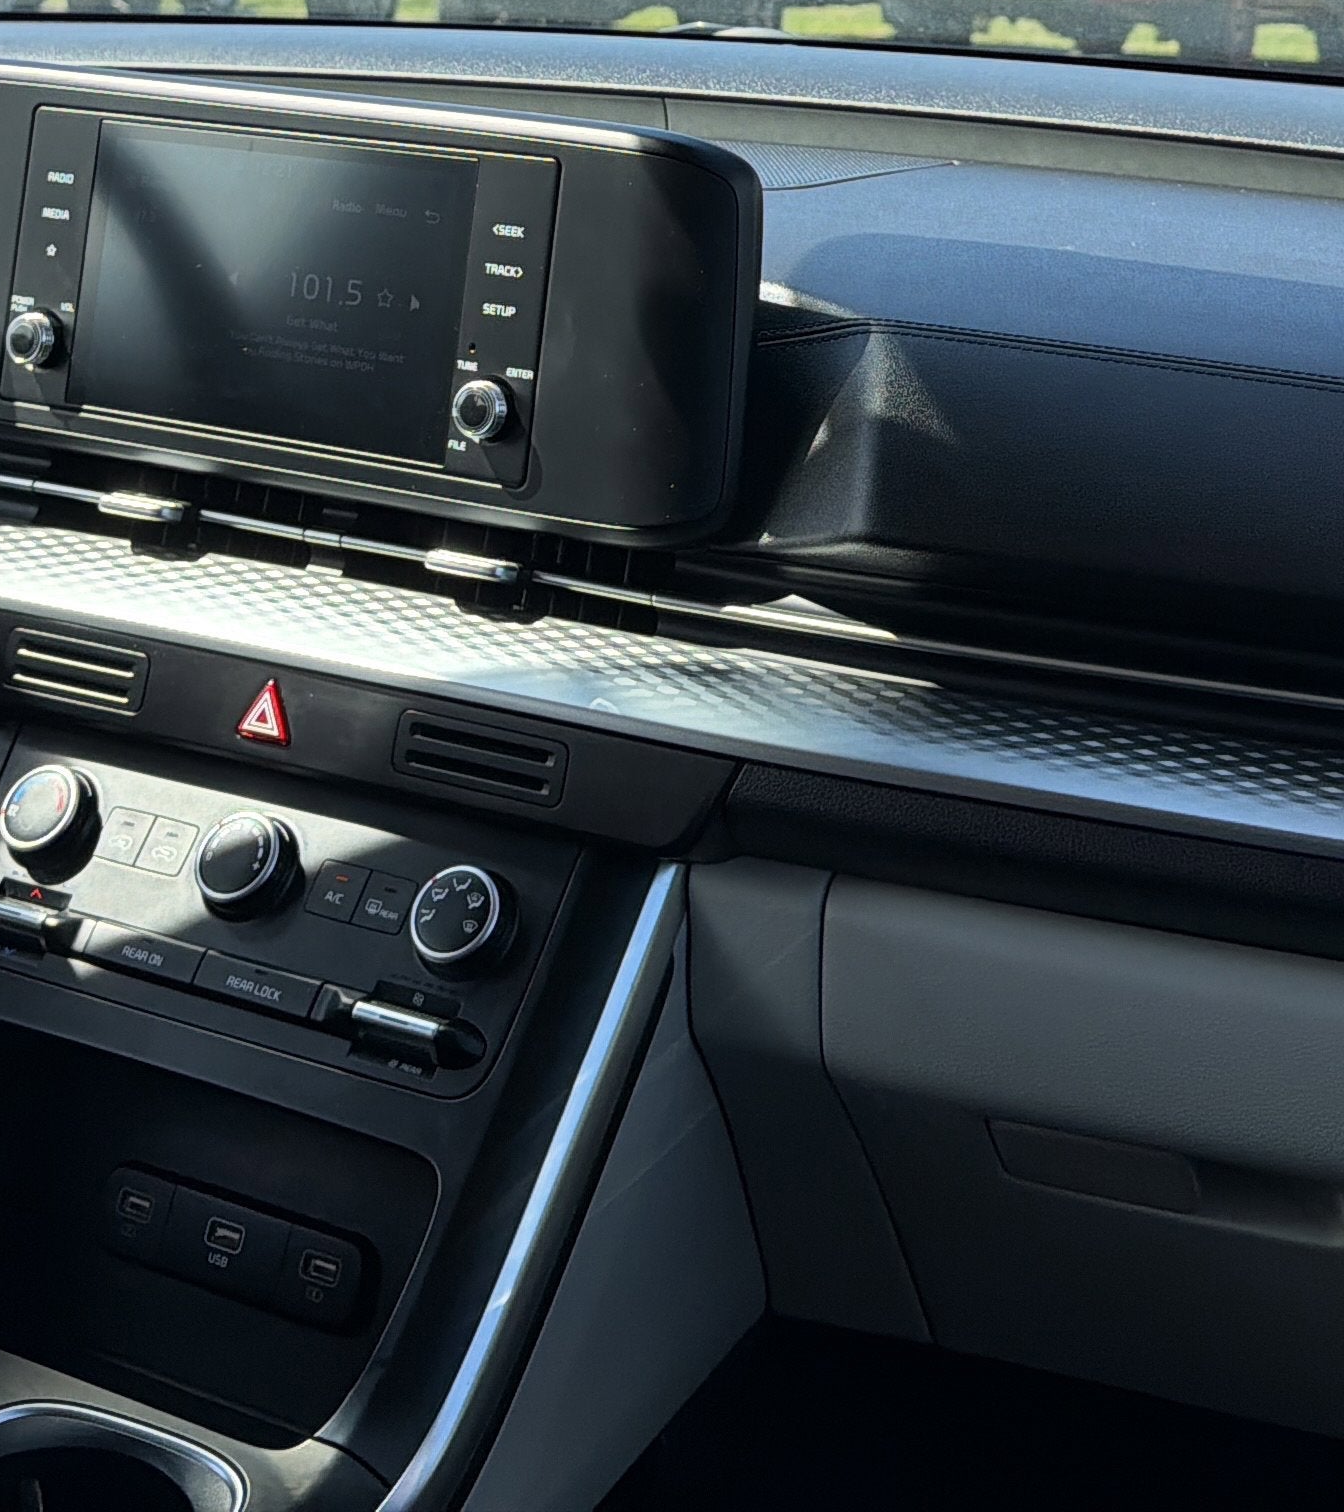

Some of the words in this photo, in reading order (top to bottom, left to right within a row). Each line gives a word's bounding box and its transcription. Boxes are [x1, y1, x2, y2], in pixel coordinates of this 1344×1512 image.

[47, 171, 74, 184] RADIO
[41, 207, 70, 221] MEDIA
[375, 203, 407, 218] Menu
[290, 272, 363, 306] 101.5
[482, 302, 517, 318] SETUP
[457, 359, 478, 372] TUNE
[506, 367, 534, 380] ENTER
[447, 439, 467, 452] FILE
[324, 890, 345, 905] A/C
[378, 909, 399, 921] REAR
[121, 945, 146, 964] REAR
[147, 952, 164, 967] ON
[225, 975, 254, 994] REAR
[255, 985, 283, 1002] LOCK
[208, 1252, 228, 1269] USB
